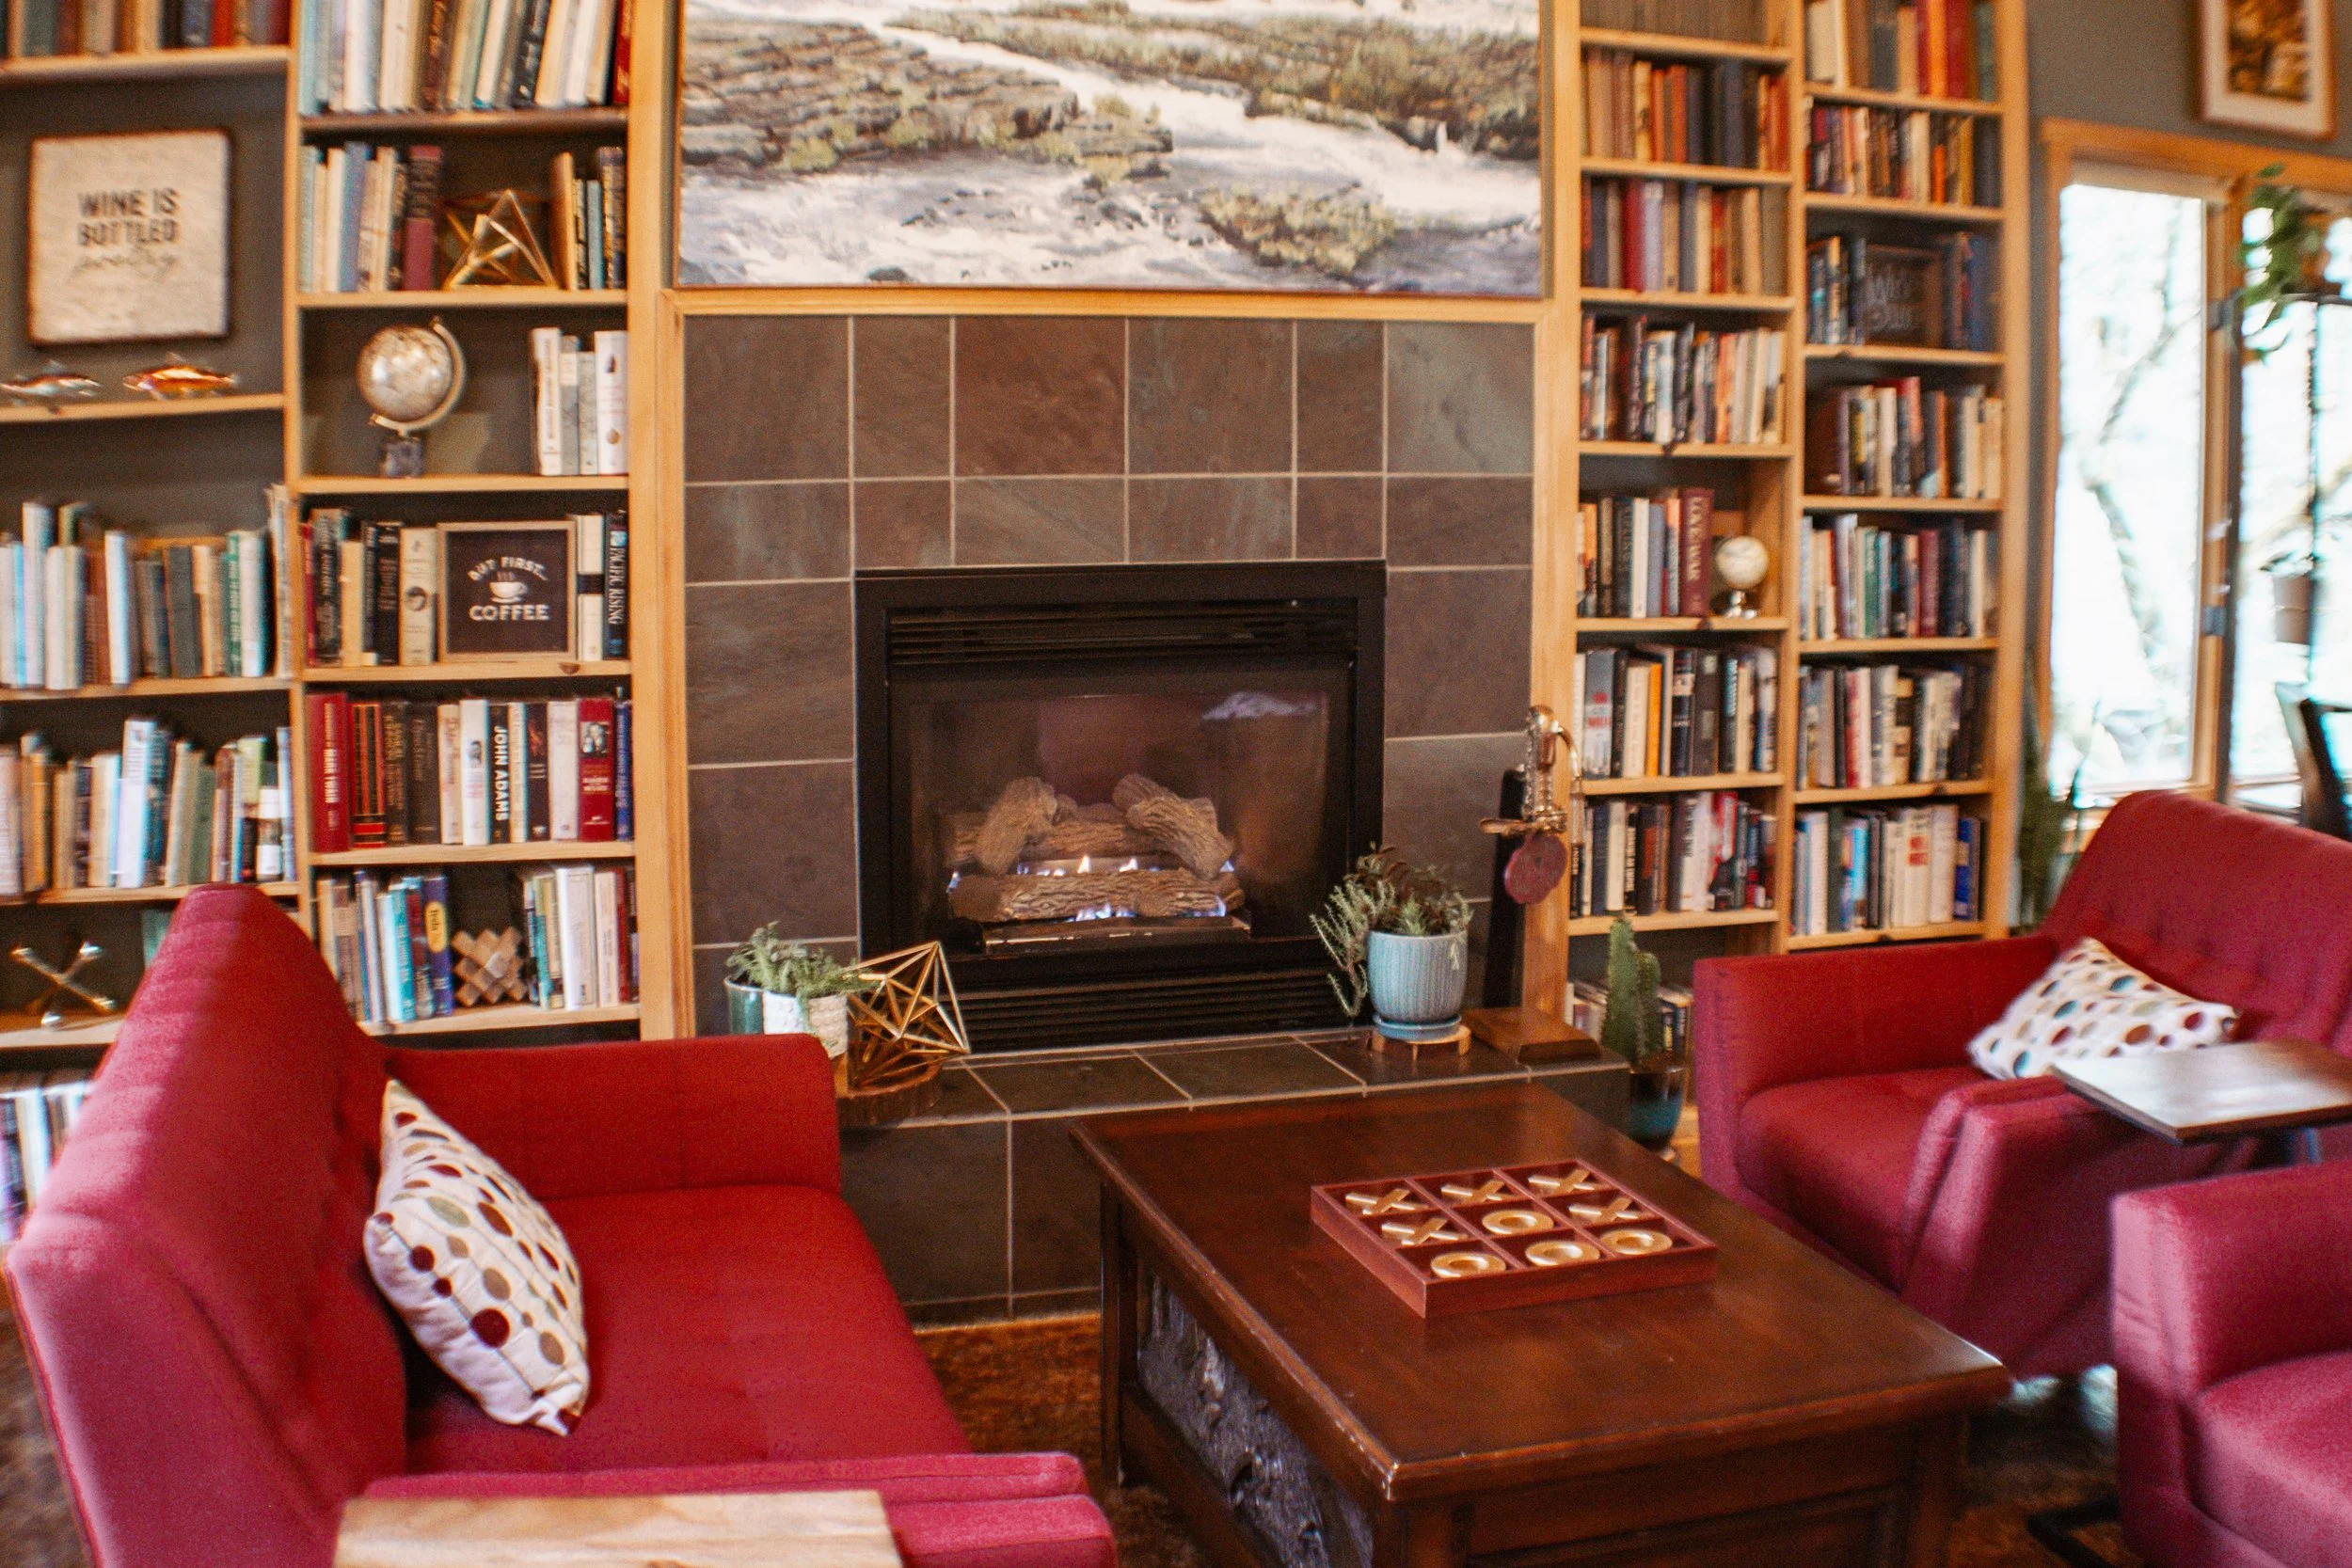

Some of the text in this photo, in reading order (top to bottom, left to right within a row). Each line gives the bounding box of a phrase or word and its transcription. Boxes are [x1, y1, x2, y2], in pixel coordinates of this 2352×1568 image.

[78, 187, 181, 218] WINE IS
[78, 218, 181, 246] BOTTLED
[468, 559, 497, 581] BUT
[608, 546, 627, 625] PACIFIC RISING
[469, 604, 550, 622] COFFEE
[494, 725, 509, 821] JOHN ADAMS
